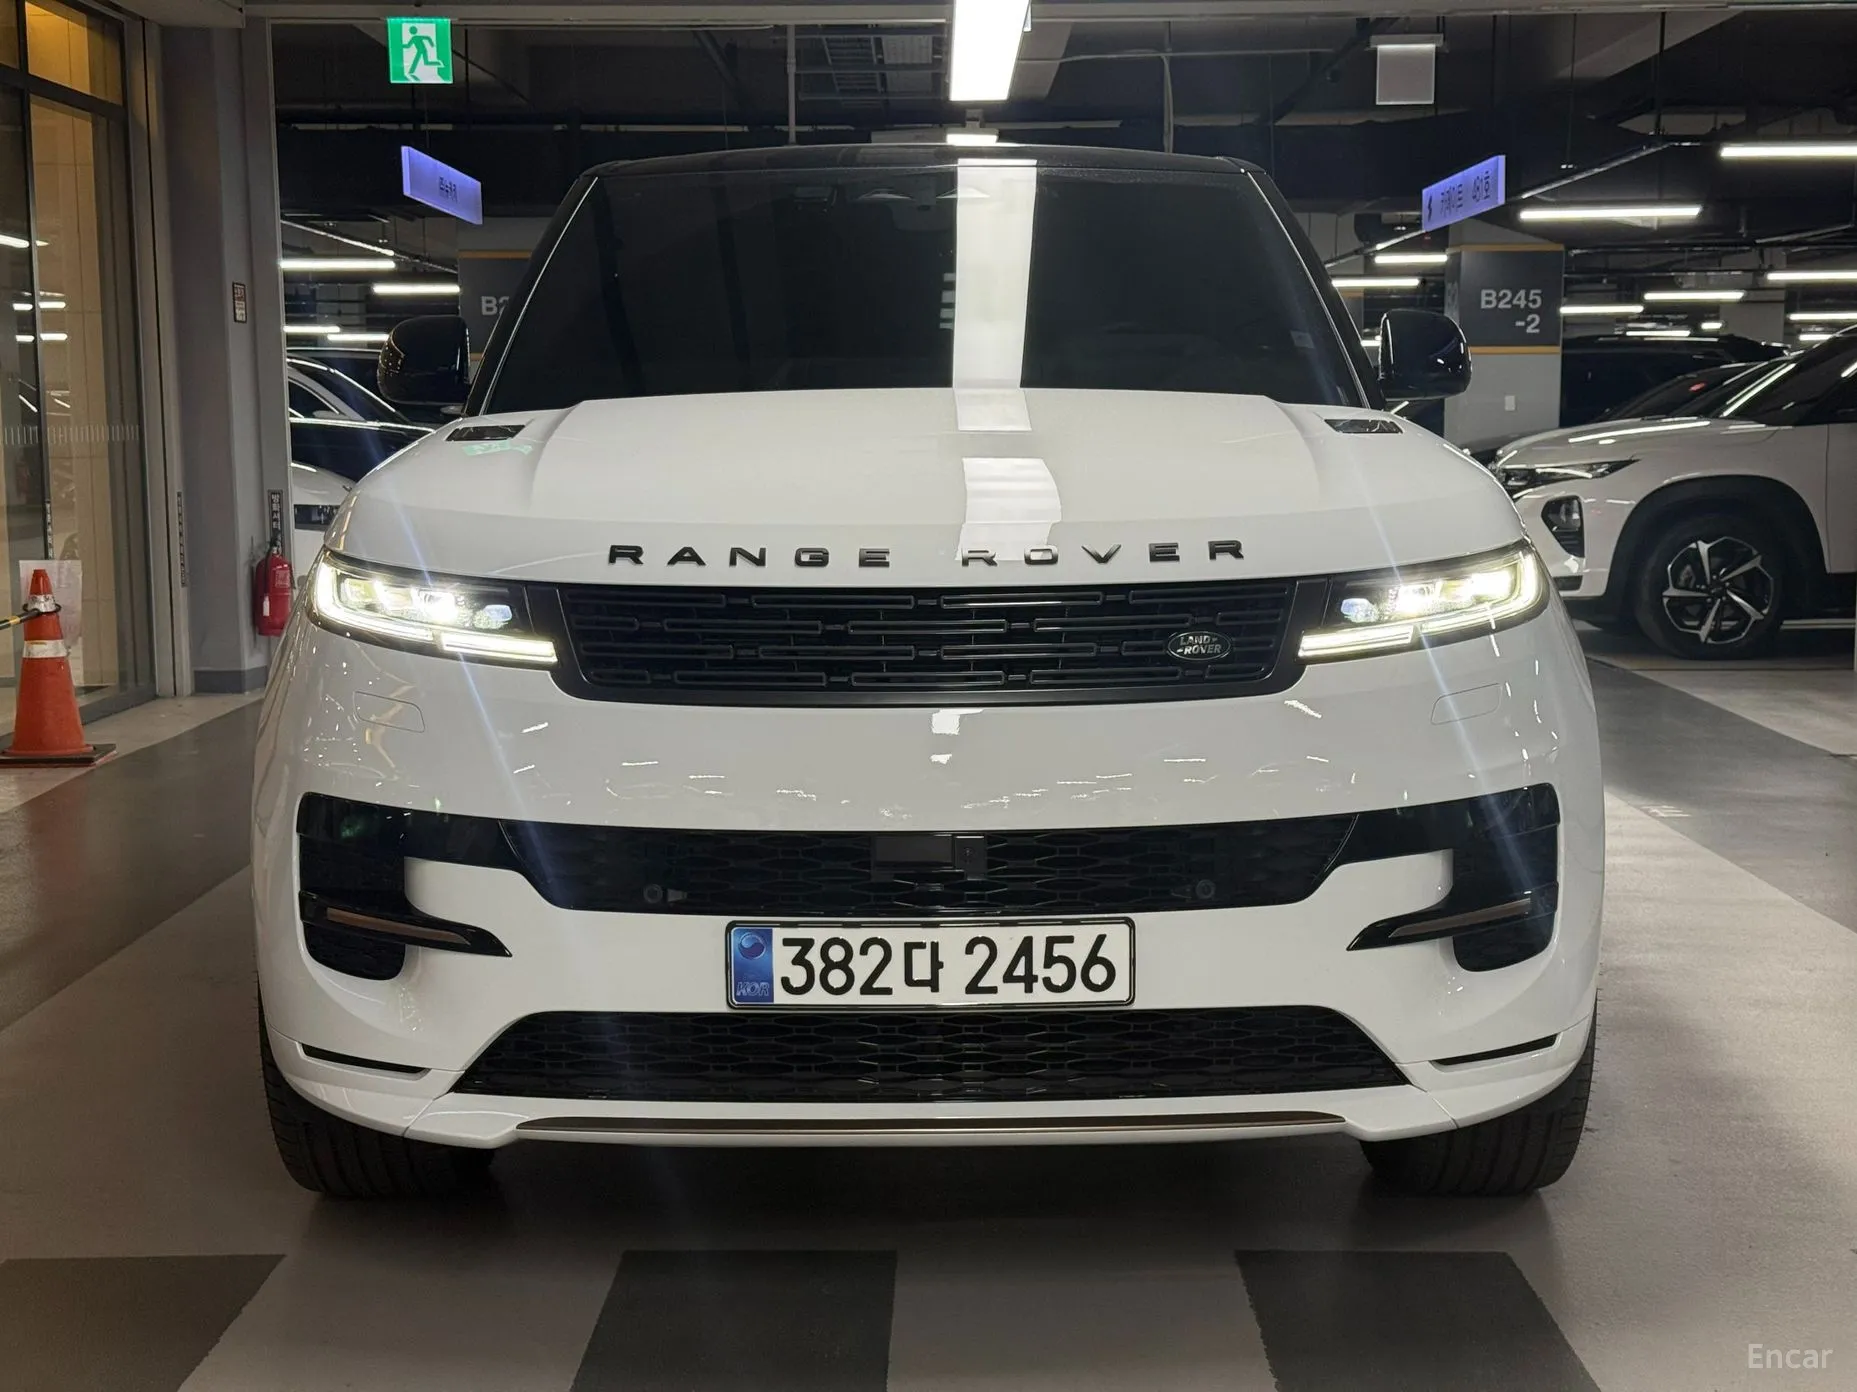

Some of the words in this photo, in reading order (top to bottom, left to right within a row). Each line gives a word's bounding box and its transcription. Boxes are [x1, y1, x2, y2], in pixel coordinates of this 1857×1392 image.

[1480, 289, 1542, 309] B245
[1515, 313, 1540, 334] -2
[608, 544, 891, 568] RANGE
[961, 539, 1245, 567] ROVER
[780, 936, 944, 996] 382다
[964, 933, 1117, 995] 2456
[735, 981, 770, 997] KOR
